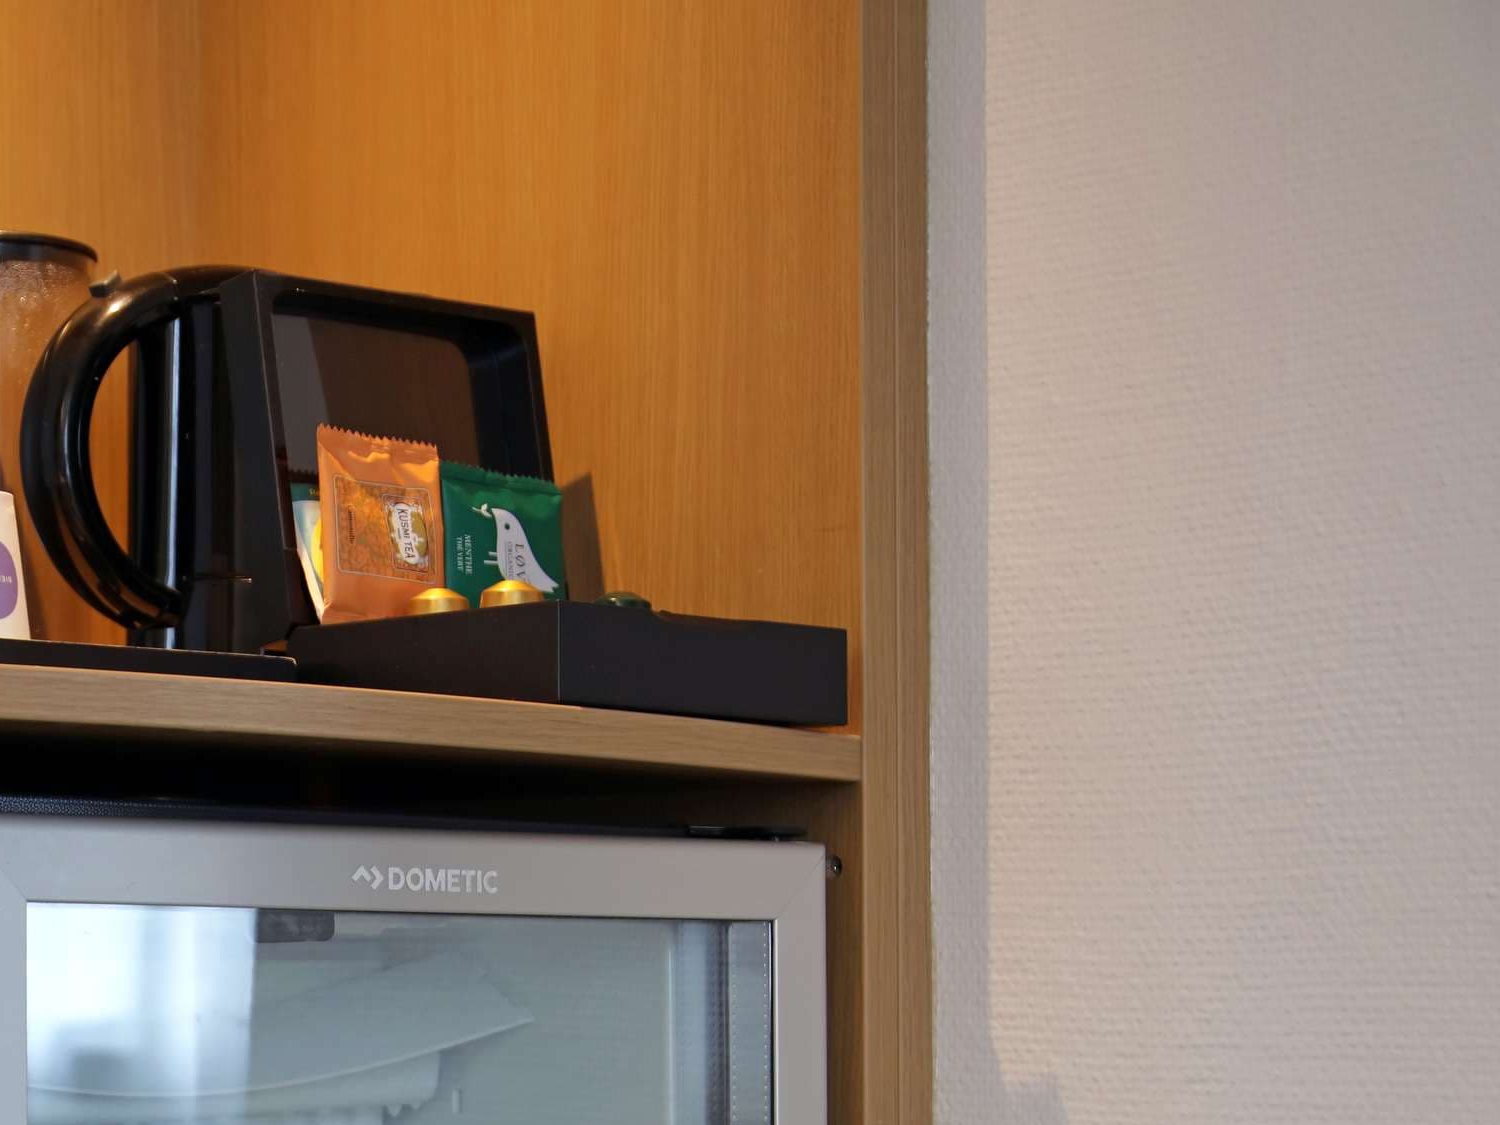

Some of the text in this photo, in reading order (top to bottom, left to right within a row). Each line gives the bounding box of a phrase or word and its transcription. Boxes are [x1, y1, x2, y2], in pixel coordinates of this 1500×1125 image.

[397, 508, 416, 559] KUSMI TEA
[388, 866, 498, 894] DOMETIC
